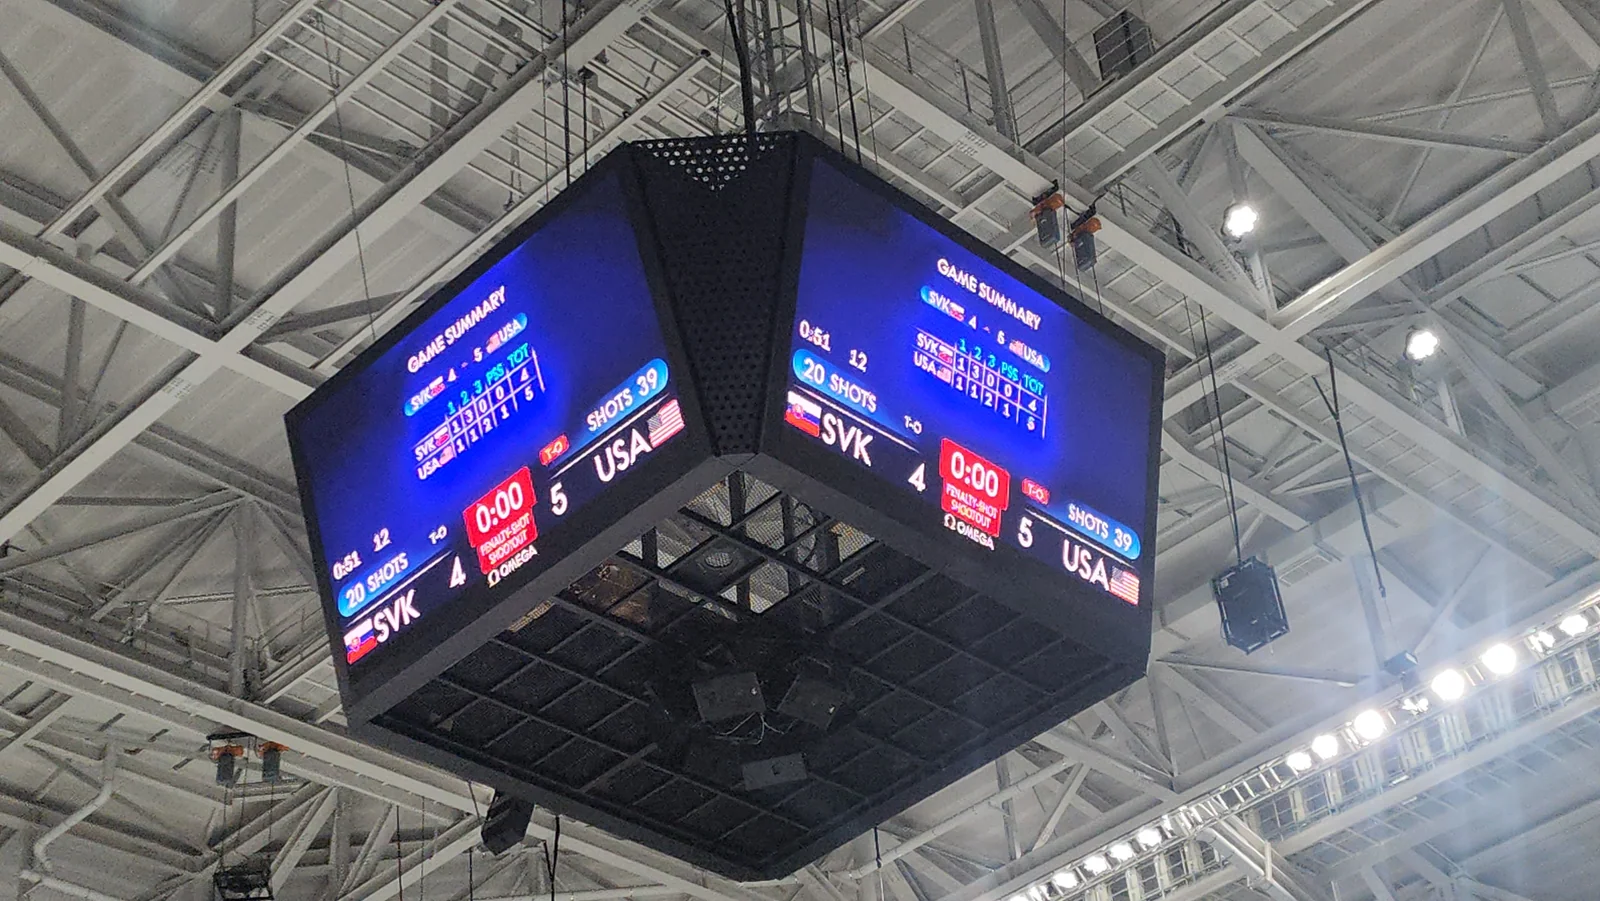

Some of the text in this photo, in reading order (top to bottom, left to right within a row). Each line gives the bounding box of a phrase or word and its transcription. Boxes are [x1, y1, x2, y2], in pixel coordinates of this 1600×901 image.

[937, 258, 1042, 331] GAME SUMMARY
[407, 285, 506, 373] GAME SUMMARY
[799, 319, 831, 351] 0:51
[928, 290, 951, 313] SVK
[968, 316, 977, 330] 4
[1023, 345, 1045, 369] USA
[410, 387, 432, 411] SVK
[447, 368, 457, 382] 4
[473, 347, 483, 362] 5
[498, 318, 522, 342] USA
[447, 342, 529, 415] 1 2 3 PSS TOT
[803, 358, 878, 414] 20 SHOTS
[849, 349, 868, 372] 12
[913, 351, 937, 376] USA
[955, 376, 963, 391] 1
[970, 384, 979, 399] 1
[984, 393, 993, 407] 2
[1003, 403, 1011, 418] 1
[916, 332, 1037, 412] SVK 1 3 0 0 4
[959, 338, 1044, 396] 1 2 3 PSS TOT
[414, 367, 530, 461] SVK 1 3 0 0 4
[586, 367, 657, 431] SHOTS 39
[417, 386, 534, 480] USA 1 1 2 1 5
[593, 428, 653, 483] USA
[821, 412, 874, 467] SVK
[550, 482, 568, 516] 5
[907, 462, 927, 492] 4
[950, 451, 999, 498] 0:00
[475, 481, 524, 534] 0:00
[946, 483, 998, 520] PENALTY-SHOT
[950, 499, 992, 528] SHOOTOUT
[1068, 503, 1133, 552] SHOTS 39
[373, 528, 392, 552] 12
[480, 512, 531, 557] PENALTY-SHOT
[487, 529, 528, 565] SHOOTOUT
[956, 521, 995, 551] OMEGA
[1017, 516, 1033, 548] 5
[333, 550, 362, 580] 0:51
[346, 552, 409, 609] 20 SHOTS
[449, 555, 467, 588] 4
[500, 544, 538, 577] OMEGA
[1062, 539, 1110, 592] USA
[373, 588, 421, 643] SVK
